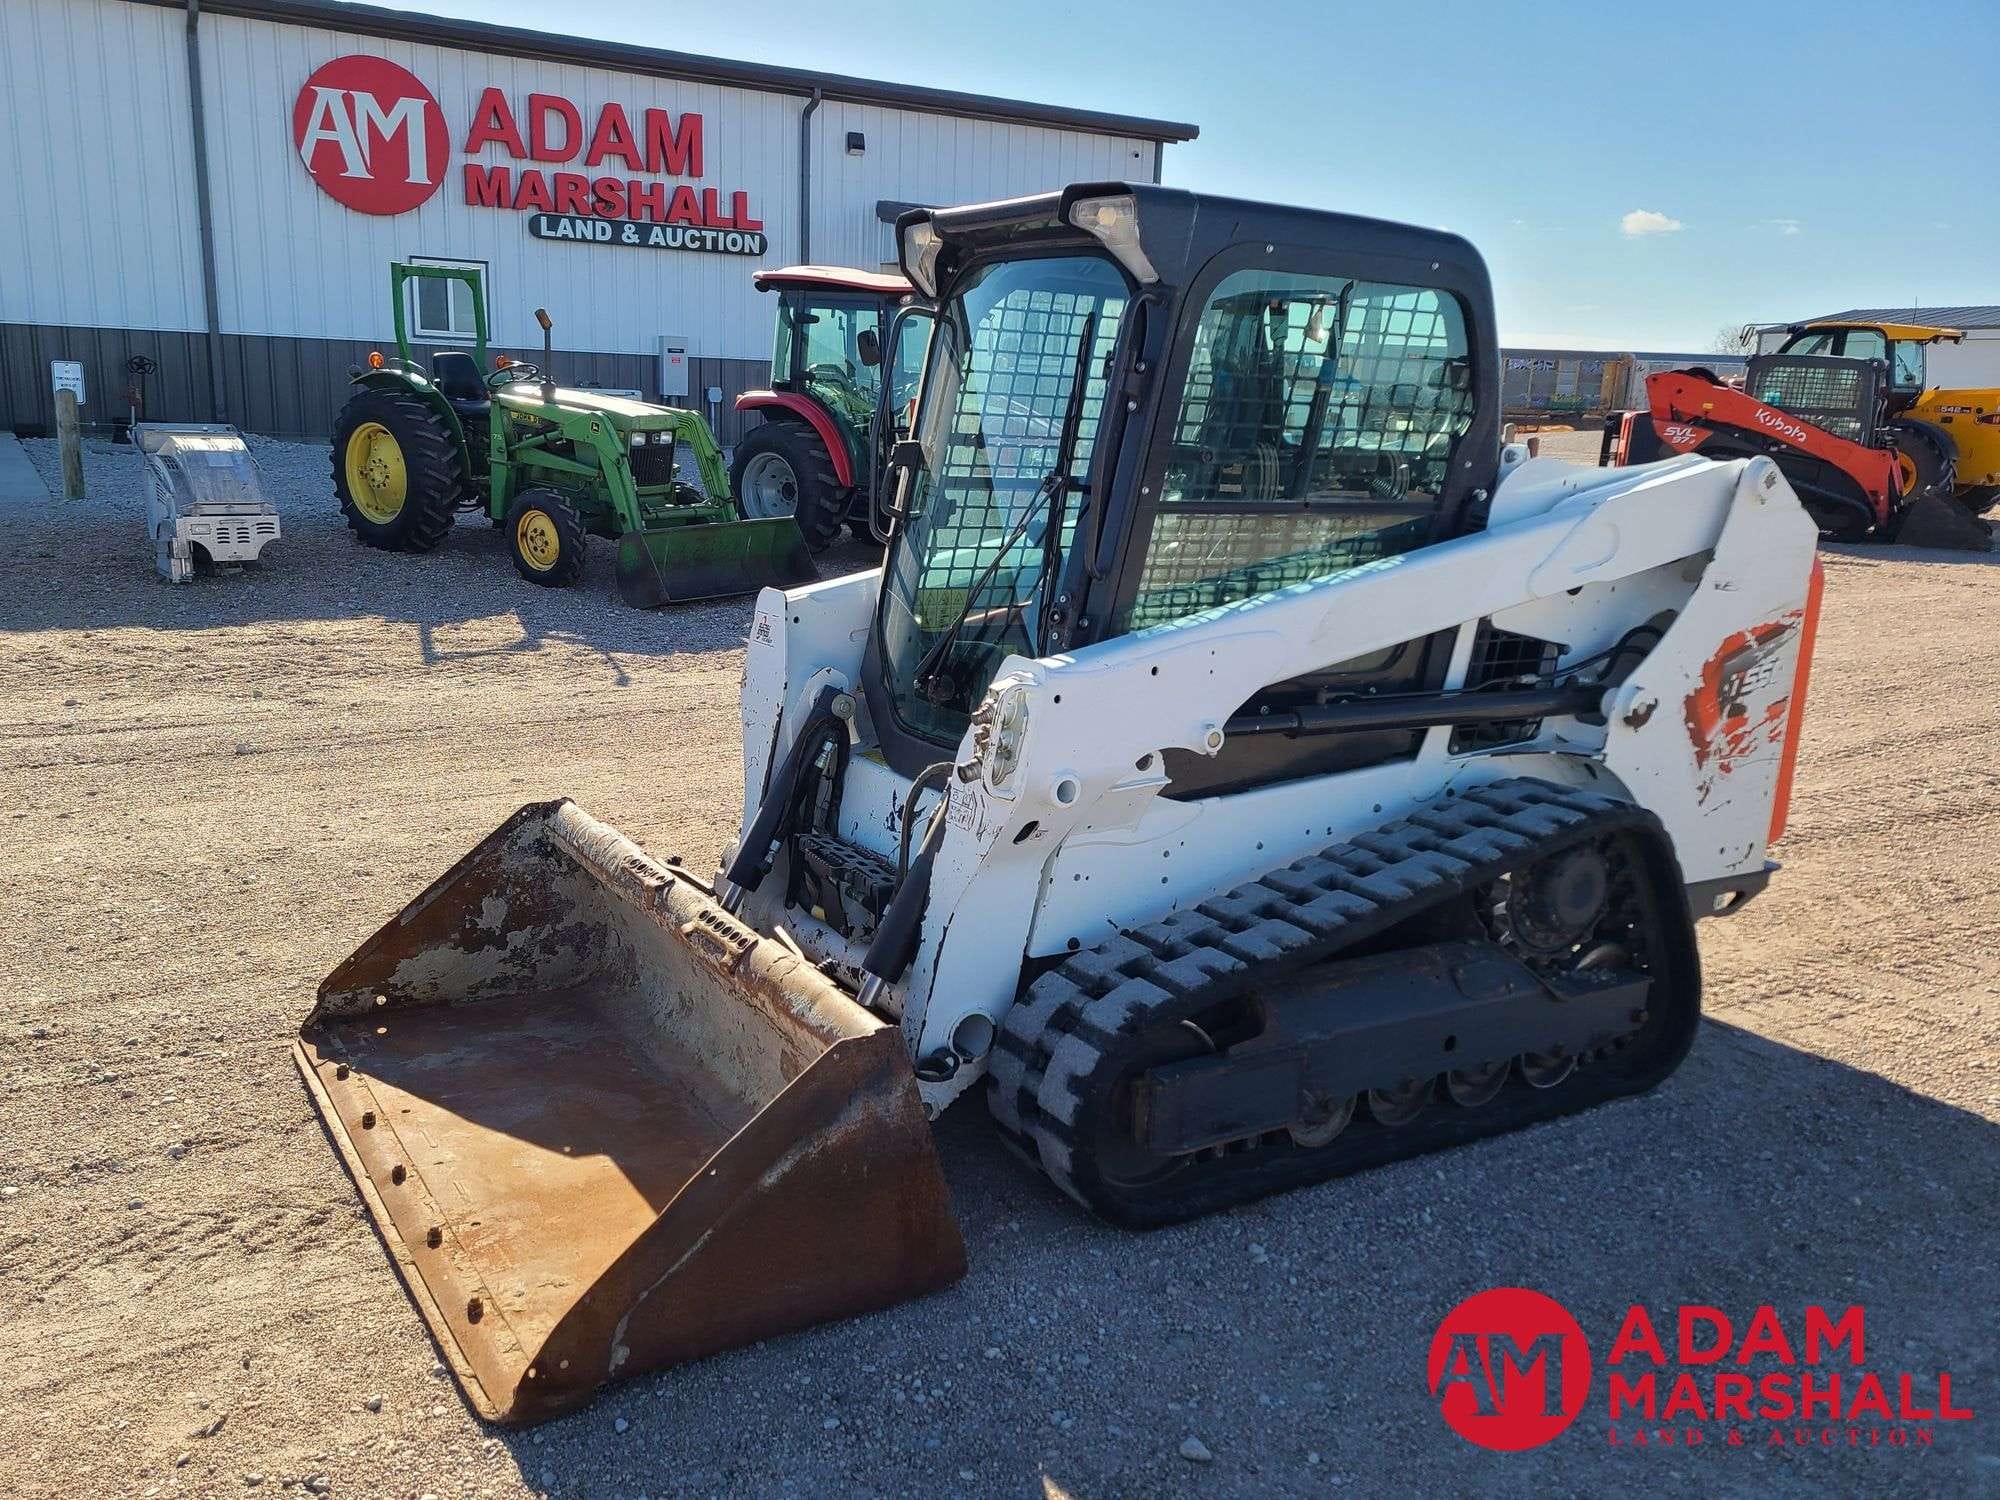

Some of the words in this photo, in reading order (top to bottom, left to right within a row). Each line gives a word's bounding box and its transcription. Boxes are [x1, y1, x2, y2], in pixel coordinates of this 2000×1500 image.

[300, 86, 433, 185] AM
[464, 87, 703, 177] ADAM
[464, 163, 764, 231] MARSHALL
[539, 216, 613, 242] LAND
[621, 223, 640, 245] &
[648, 226, 760, 254] AUCTION
[1663, 426, 1697, 437] SVL
[1754, 407, 1808, 442] Kubota
